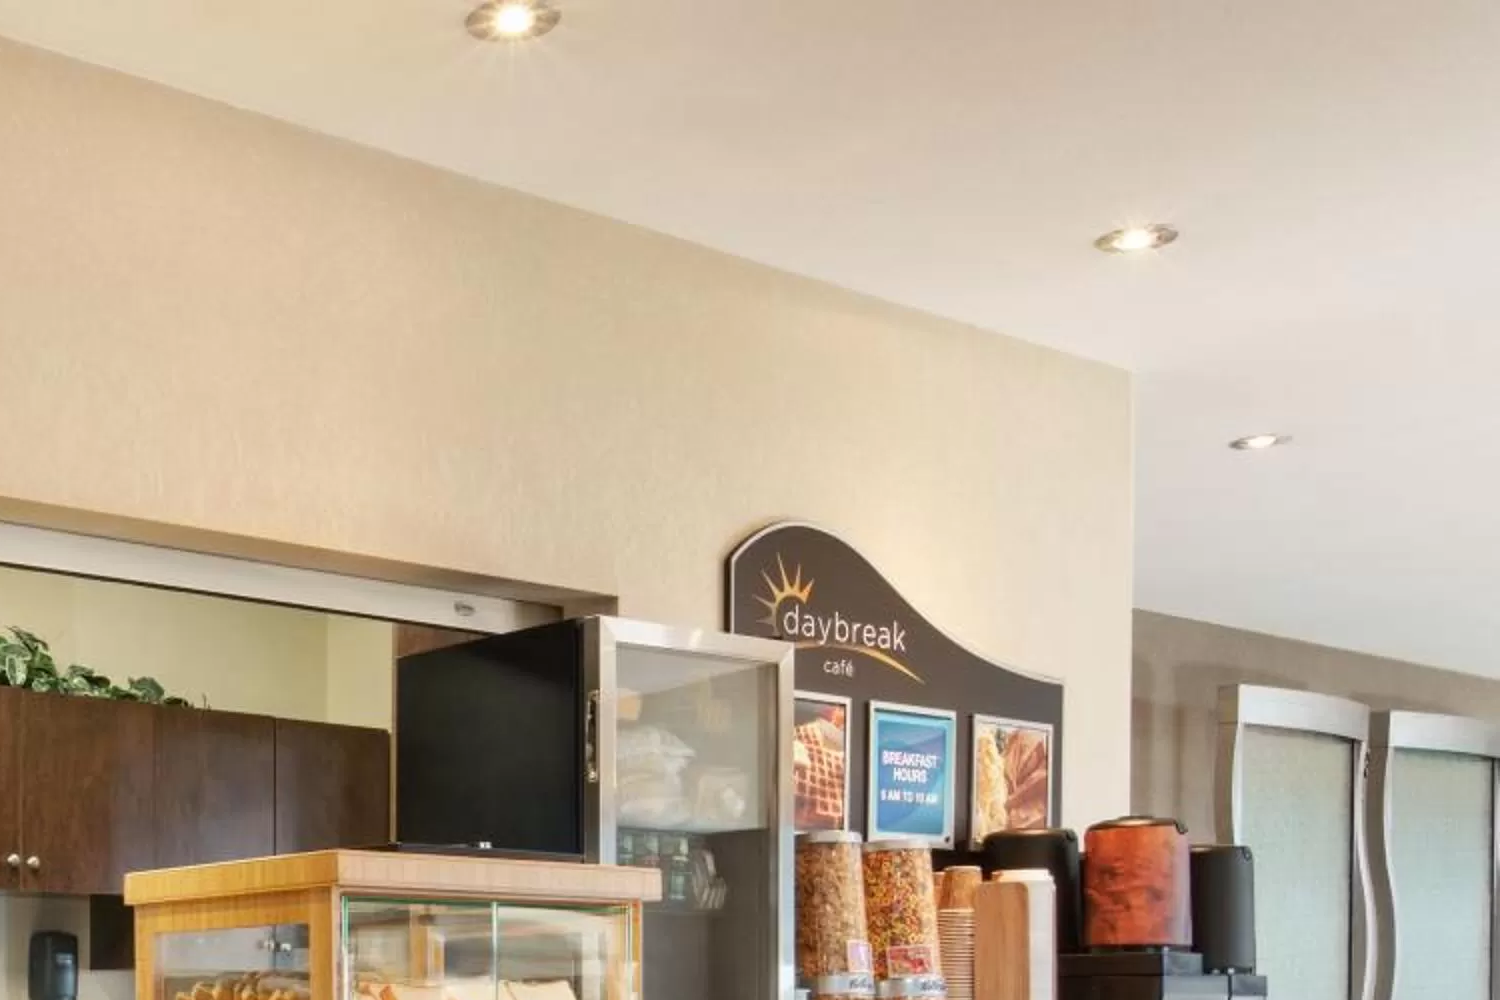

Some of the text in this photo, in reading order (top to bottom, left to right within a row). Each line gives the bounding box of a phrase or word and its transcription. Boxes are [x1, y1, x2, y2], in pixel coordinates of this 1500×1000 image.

[783, 604, 906, 651] daybreak
[823, 659, 854, 678] café
[881, 750, 939, 768] BREAKFAST
[893, 767, 927, 784] HOURS
